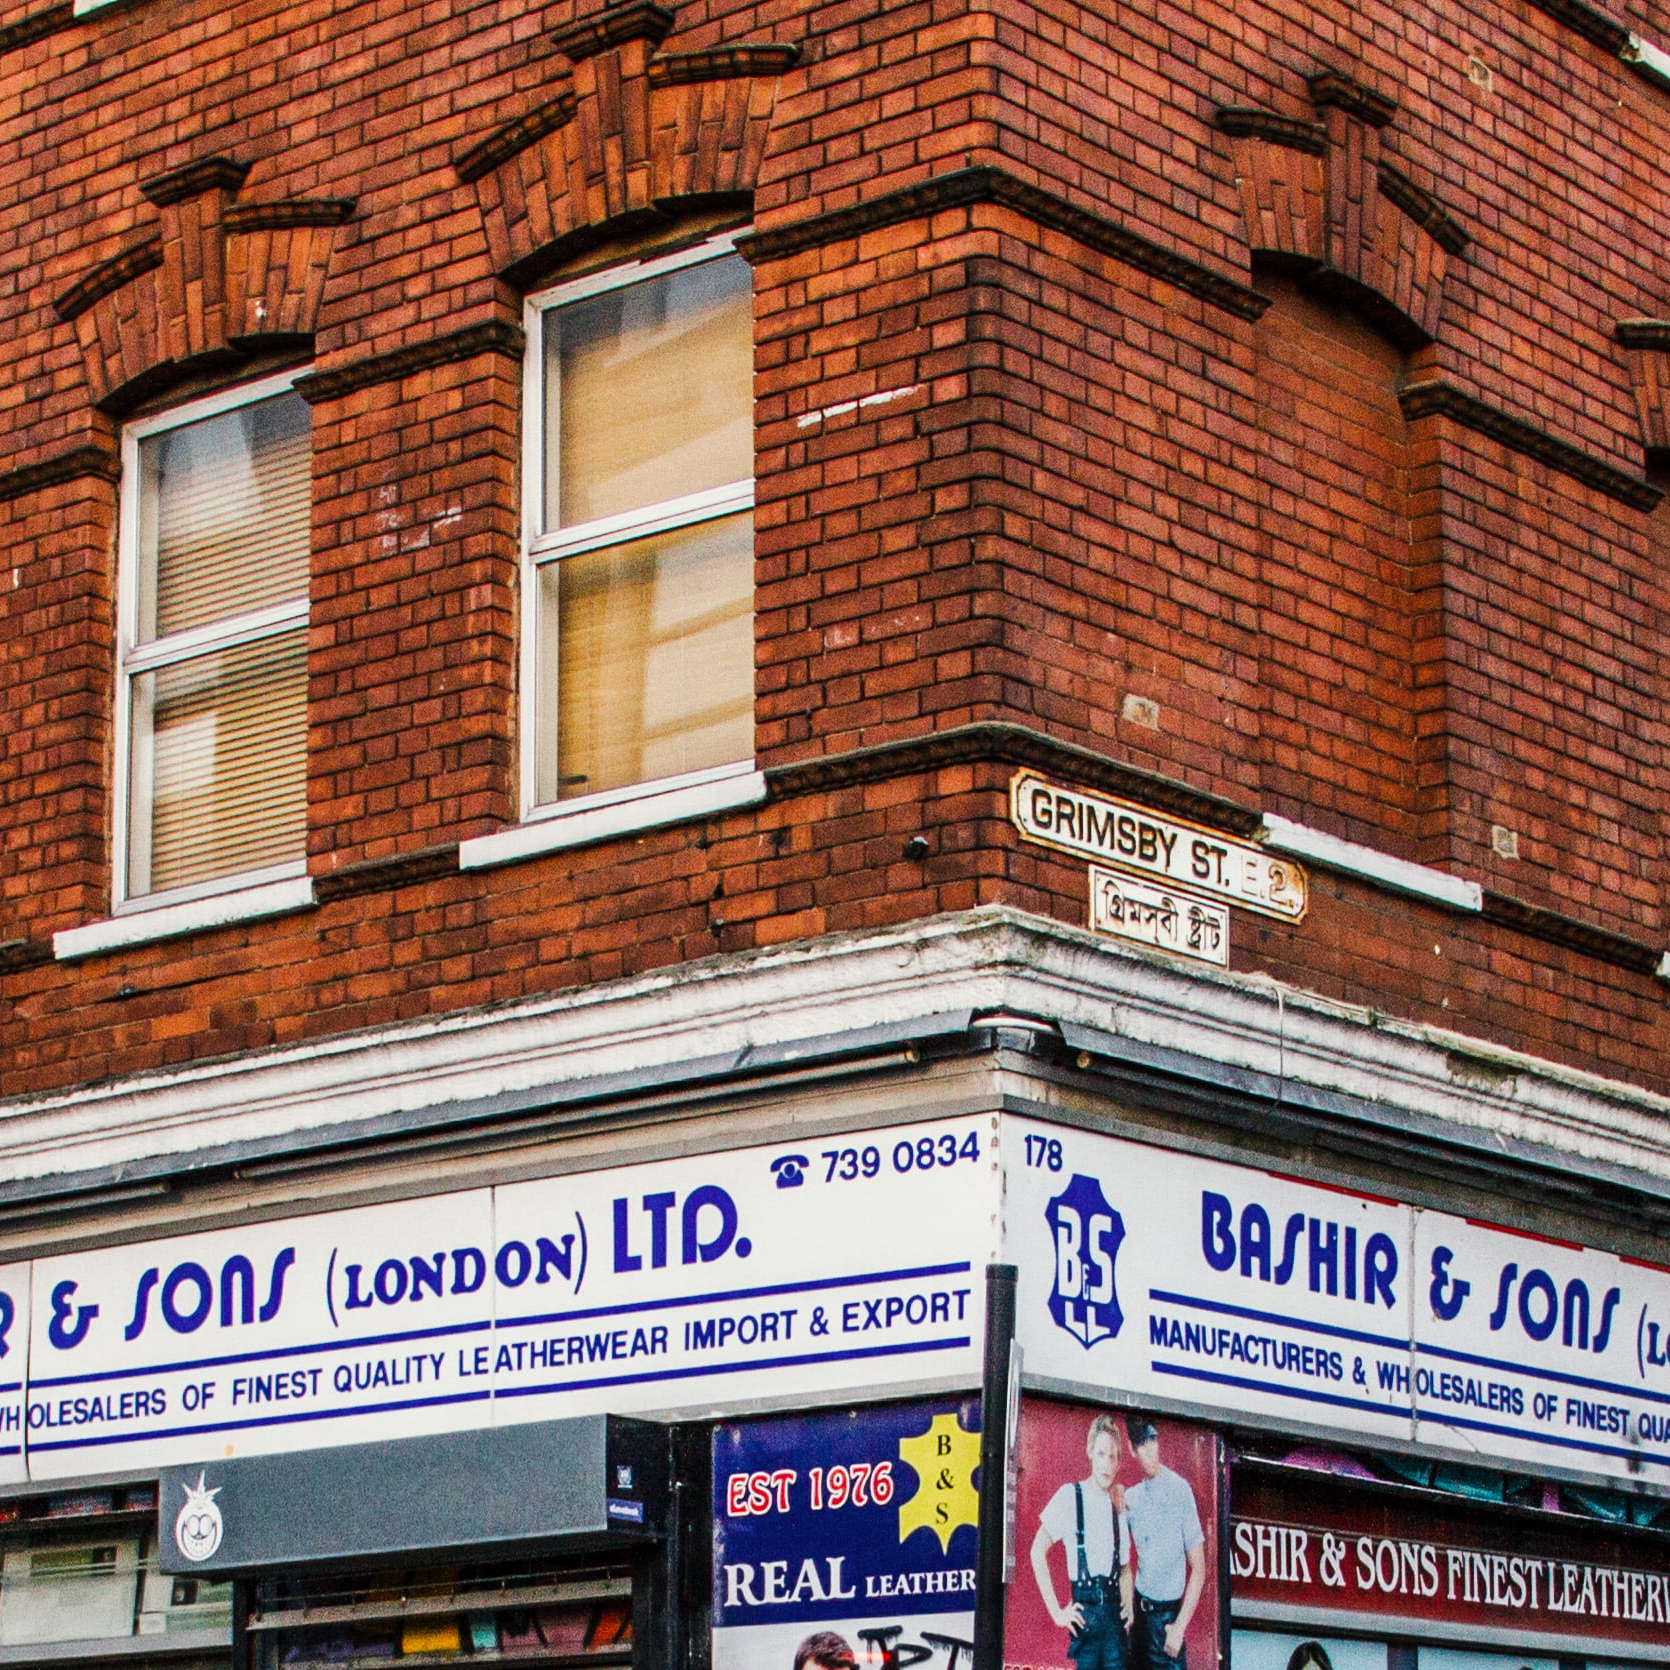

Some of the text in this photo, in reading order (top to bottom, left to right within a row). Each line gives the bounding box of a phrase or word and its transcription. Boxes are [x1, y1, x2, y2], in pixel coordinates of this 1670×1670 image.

[1031, 788, 1177, 872] GRIMSBY
[1191, 840, 1229, 886] ST.
[821, 1130, 981, 1184] 739 0834
[1024, 1134, 1063, 1172] 178
[48, 1279, 99, 1350] &
[124, 1246, 296, 1341] SONS
[326, 1211, 590, 1327] (LONDON)
[612, 1183, 753, 1274] LTD.
[1201, 1190, 1399, 1309] BASHIR
[1430, 1246, 1470, 1322] &
[1490, 1263, 1621, 1354] SONS
[182, 1381, 216, 1410] OF
[231, 1369, 323, 1407] FINEST
[334, 1351, 445, 1393] QUALITY
[458, 1325, 669, 1378] LEATHERWEAR
[684, 1310, 798, 1352] IMPORT
[809, 1307, 830, 1335] &
[841, 1288, 971, 1333] EXPORT
[1149, 1314, 1344, 1382] MANUFACTURERS
[1352, 1356, 1366, 1385] &
[1377, 1359, 1525, 1416] WHOLESALERS
[1533, 1391, 1558, 1422] OF
[1566, 1398, 1630, 1437] FINEST
[936, 1434, 951, 1456] B
[727, 1460, 893, 1517] EST 1976
[936, 1469, 954, 1491] &
[935, 1502, 949, 1525] S
[723, 1556, 856, 1607] REAL
[1320, 1531, 1346, 1587] &
[1356, 1536, 1439, 1597] SONS
[1446, 1549, 1545, 1608] FINEST
